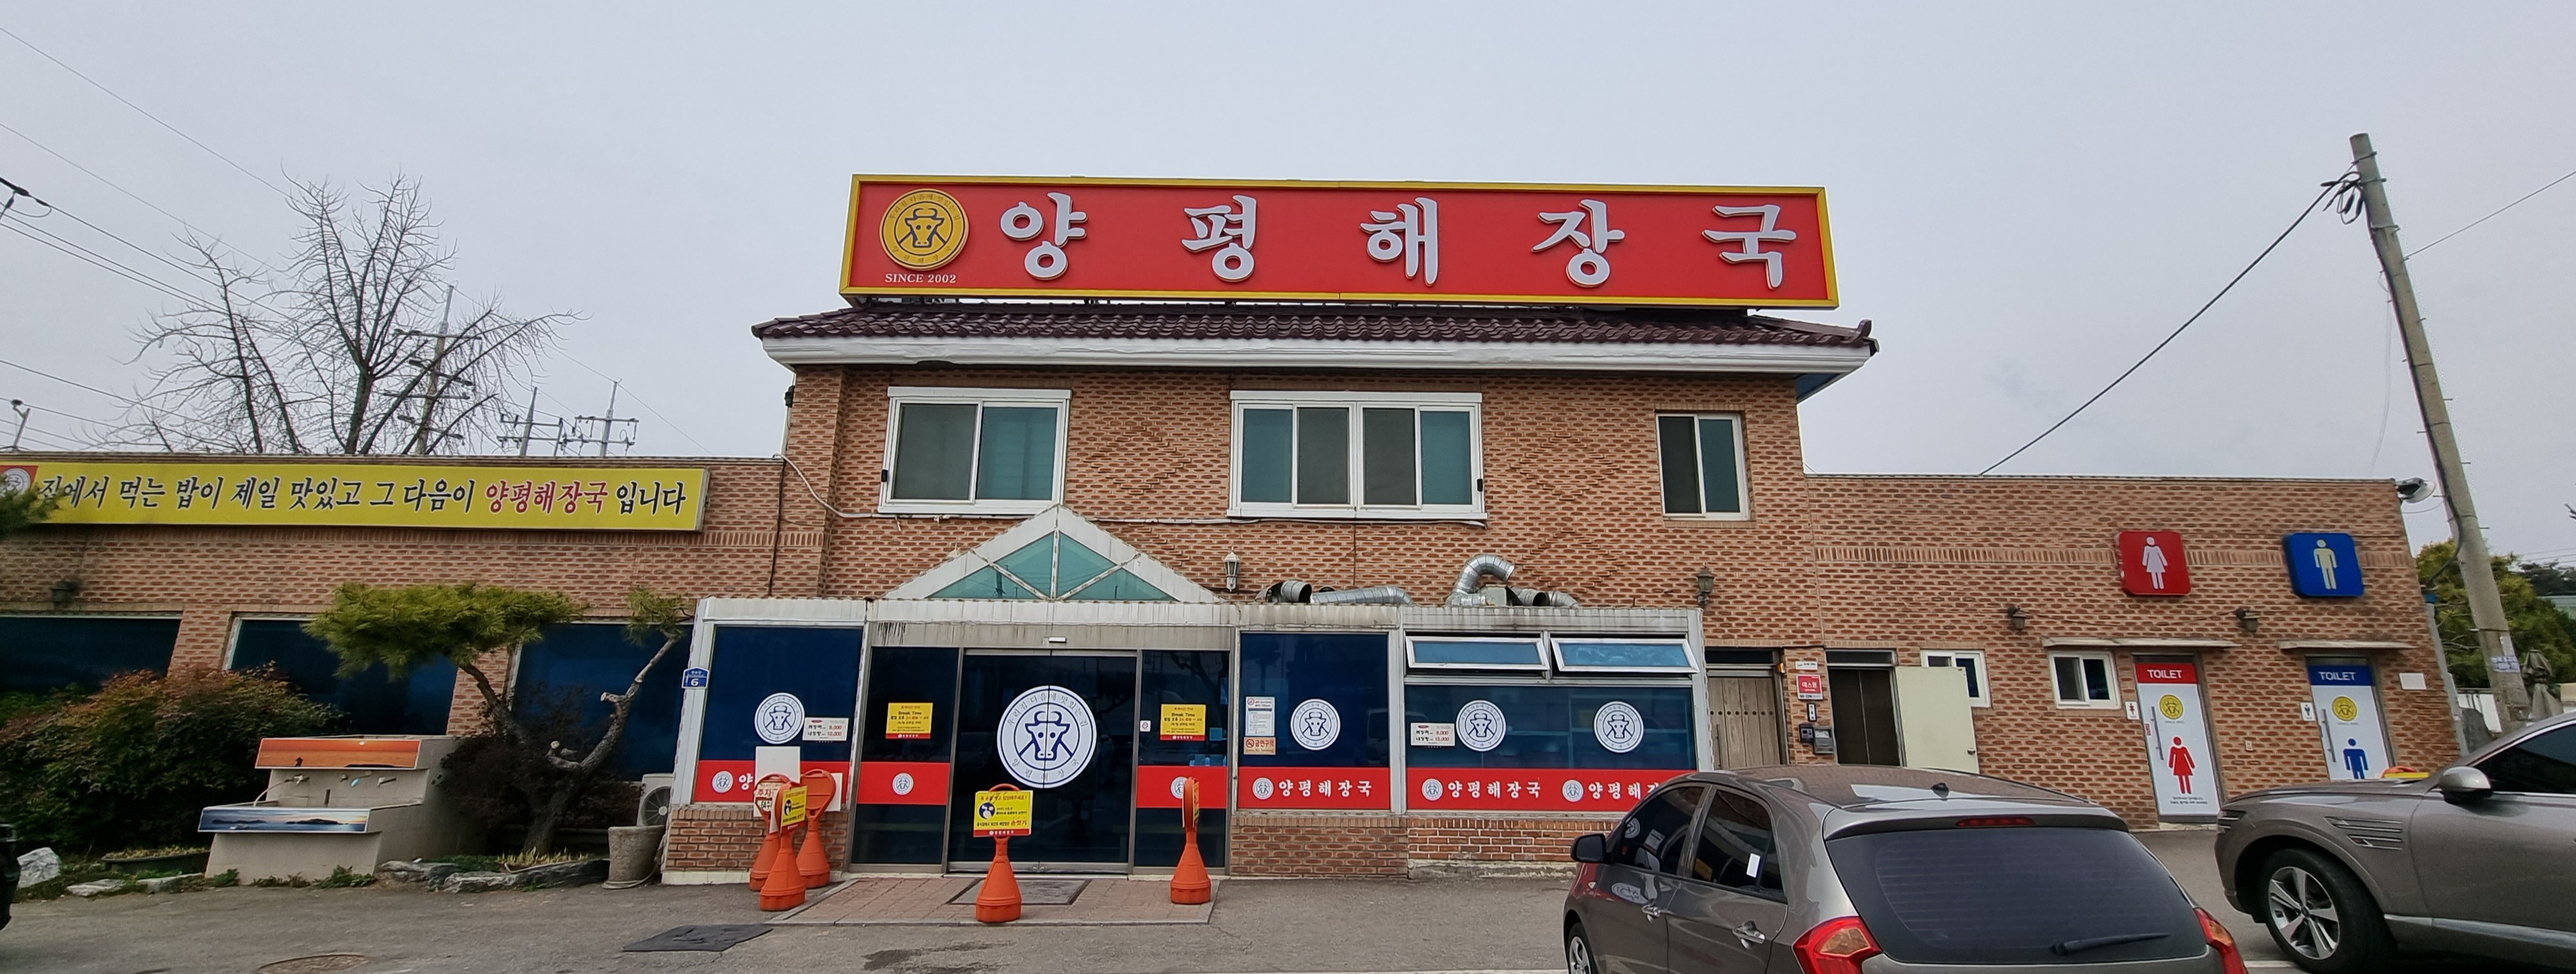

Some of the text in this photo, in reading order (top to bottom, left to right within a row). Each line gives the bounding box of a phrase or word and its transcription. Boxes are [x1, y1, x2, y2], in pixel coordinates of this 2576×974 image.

[1000, 192, 1797, 290] 양평해장국
[885, 273, 956, 284] SINCE 2002
[39, 475, 687, 515] 집에서 먹는 밥이 제일 맛있고 그 다음이 양평해장국 입니다
[2147, 669, 2183, 679] TOILET
[2318, 672, 2356, 681] TOILET
[1279, 779, 1372, 798] 양평해장국
[1448, 780, 1541, 799] 양평해장국
